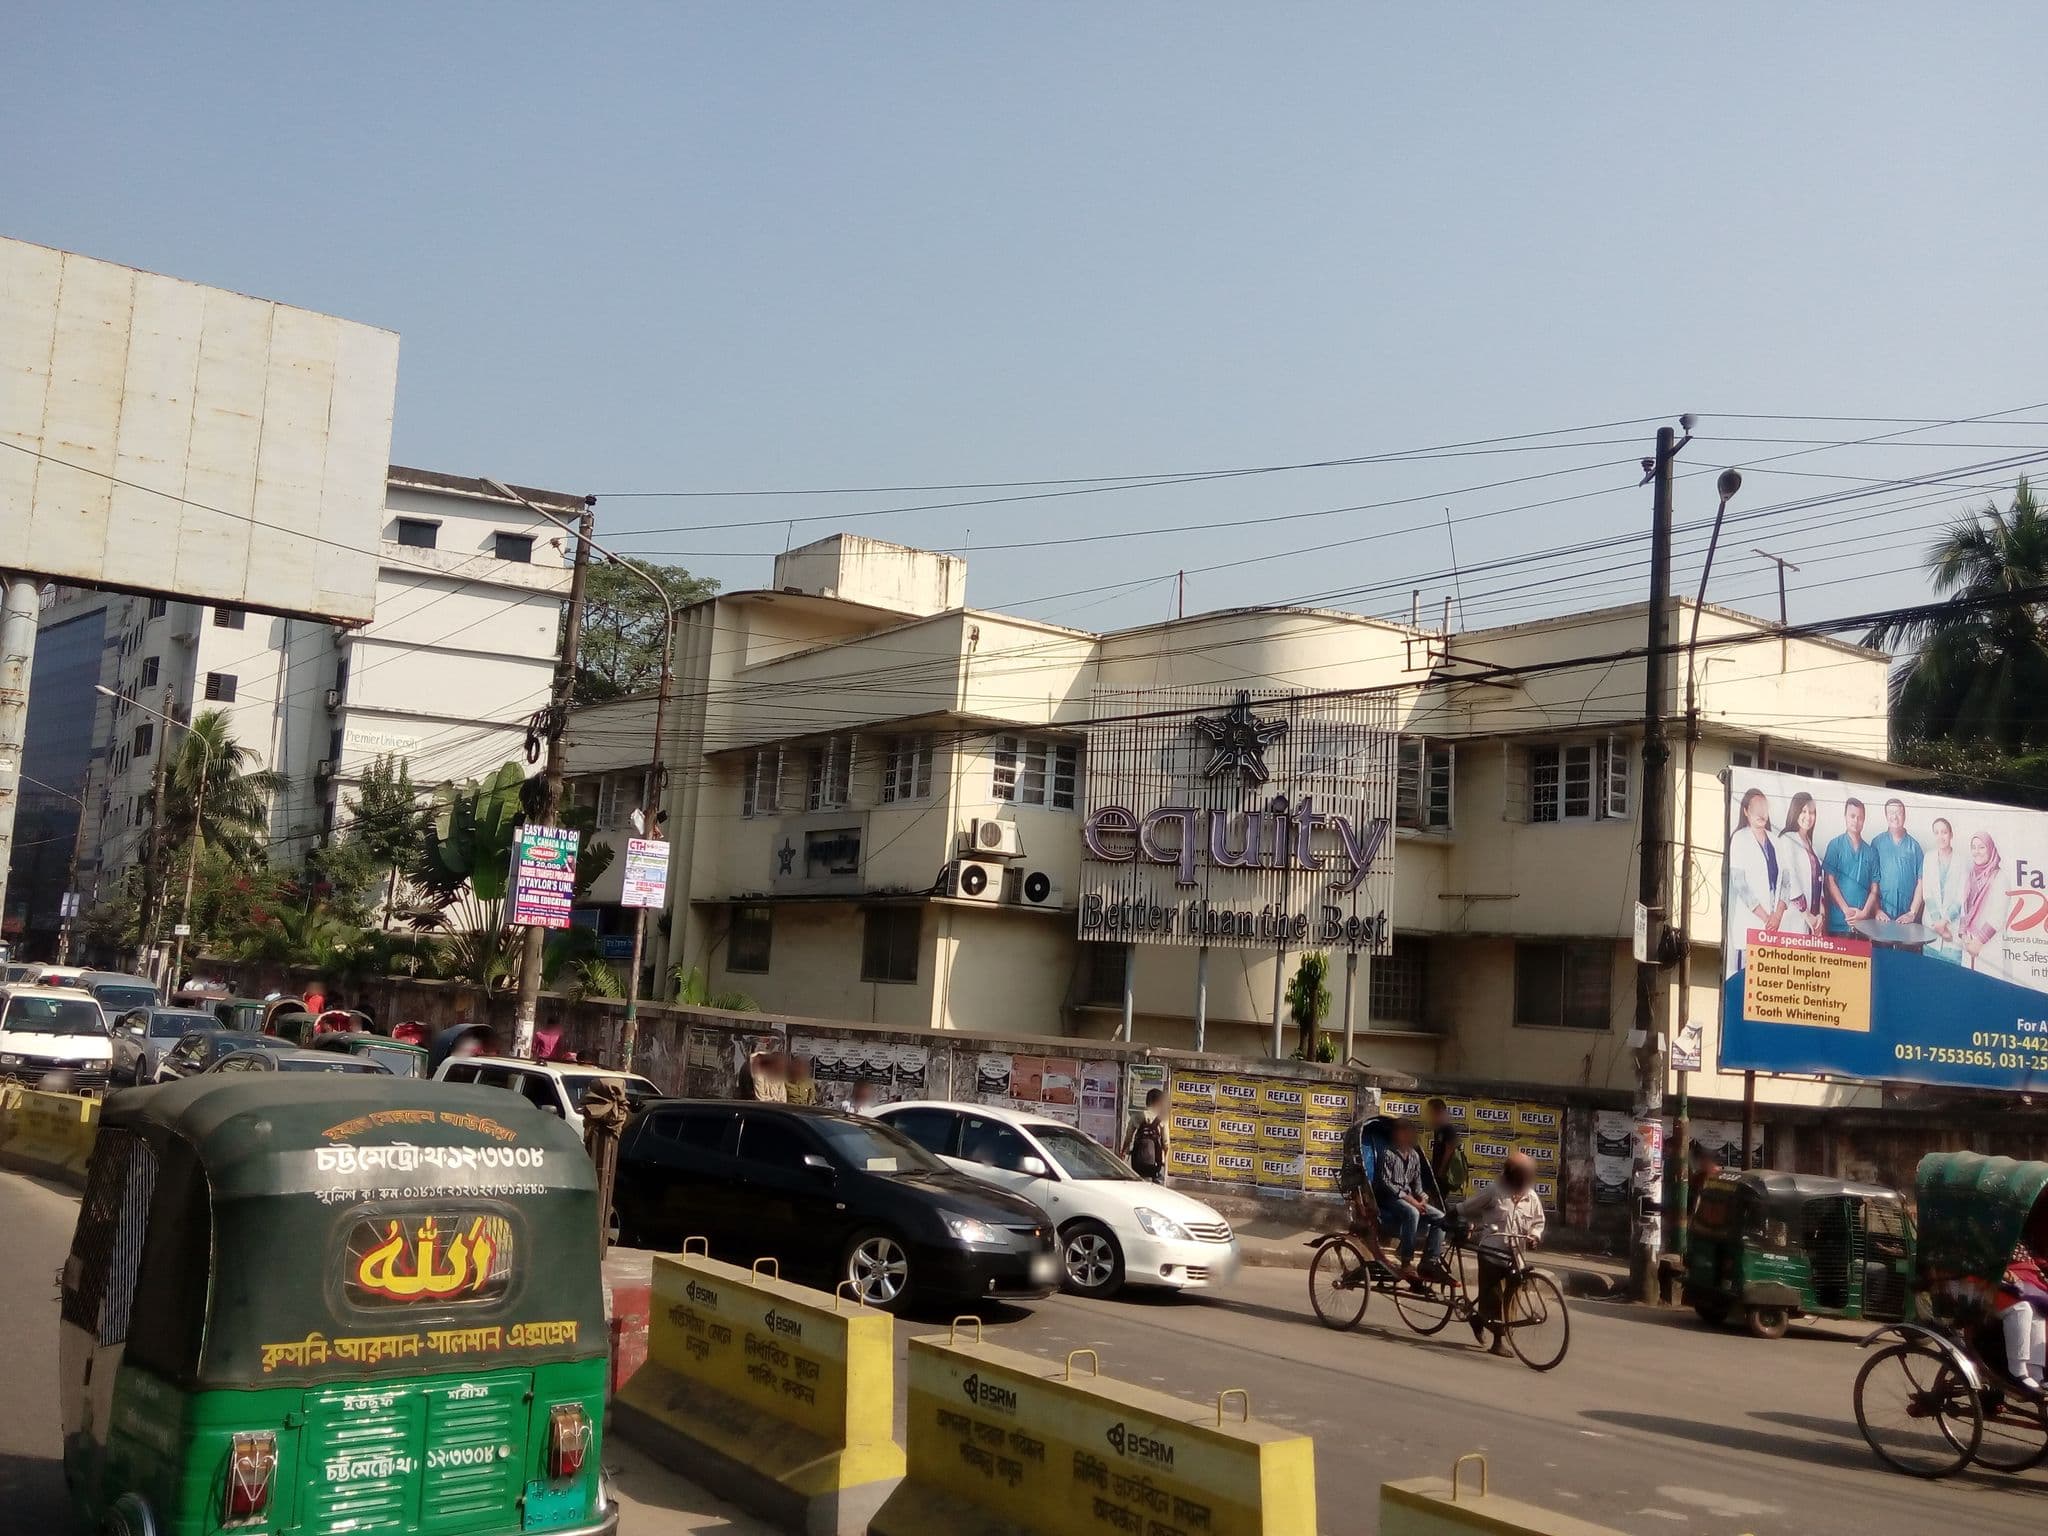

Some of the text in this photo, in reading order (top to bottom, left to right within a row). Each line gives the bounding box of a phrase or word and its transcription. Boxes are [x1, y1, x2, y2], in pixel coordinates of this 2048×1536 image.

[345, 729, 380, 744] Premier
[524, 824, 578, 841] EASY WAY TO GO
[1085, 795, 1391, 892] equity
[526, 877, 557, 889] TAYLOR'S
[2005, 888, 2048, 935] D
[1084, 893, 1388, 944] Better than the Best
[1758, 931, 1778, 943] Our
[1780, 935, 1834, 950] specialities
[1757, 947, 1867, 969] Orthodontic treatment
[2002, 948, 2021, 961] The
[1757, 962, 1830, 980] Dental Implant
[2031, 967, 2040, 977] in
[1757, 976, 1831, 996] Laser Dentistry
[1756, 991, 1848, 1012] Cosmetic Dentistry
[1755, 1005, 1782, 1018] Tooth
[2017, 1018, 2037, 1032] For
[1894, 1043, 1996, 1068] 031-7553565,
[1178, 1082, 1211, 1093] REFLEX
[1221, 1085, 1255, 1098] REFLEX
[1267, 1090, 1301, 1102] REFLEX
[1313, 1095, 1347, 1106] REFLEX
[1387, 1103, 1420, 1114] REFLEX
[1476, 1109, 1509, 1121] REFLEX
[1175, 1117, 1209, 1129] REFLEX
[1521, 1113, 1553, 1124] REFLEX
[1220, 1121, 1254, 1133] REFLEX
[1265, 1126, 1299, 1138] REFLEX
[1474, 1144, 1507, 1156] REFLEX
[1174, 1152, 1208, 1164] REFLEX
[1218, 1155, 1252, 1168] REFLEX
[695, 1286, 718, 1305] BSRM
[776, 1316, 802, 1337] BSRM
[980, 1382, 1017, 1409] BSRM
[1127, 1432, 1174, 1465] BSRM
